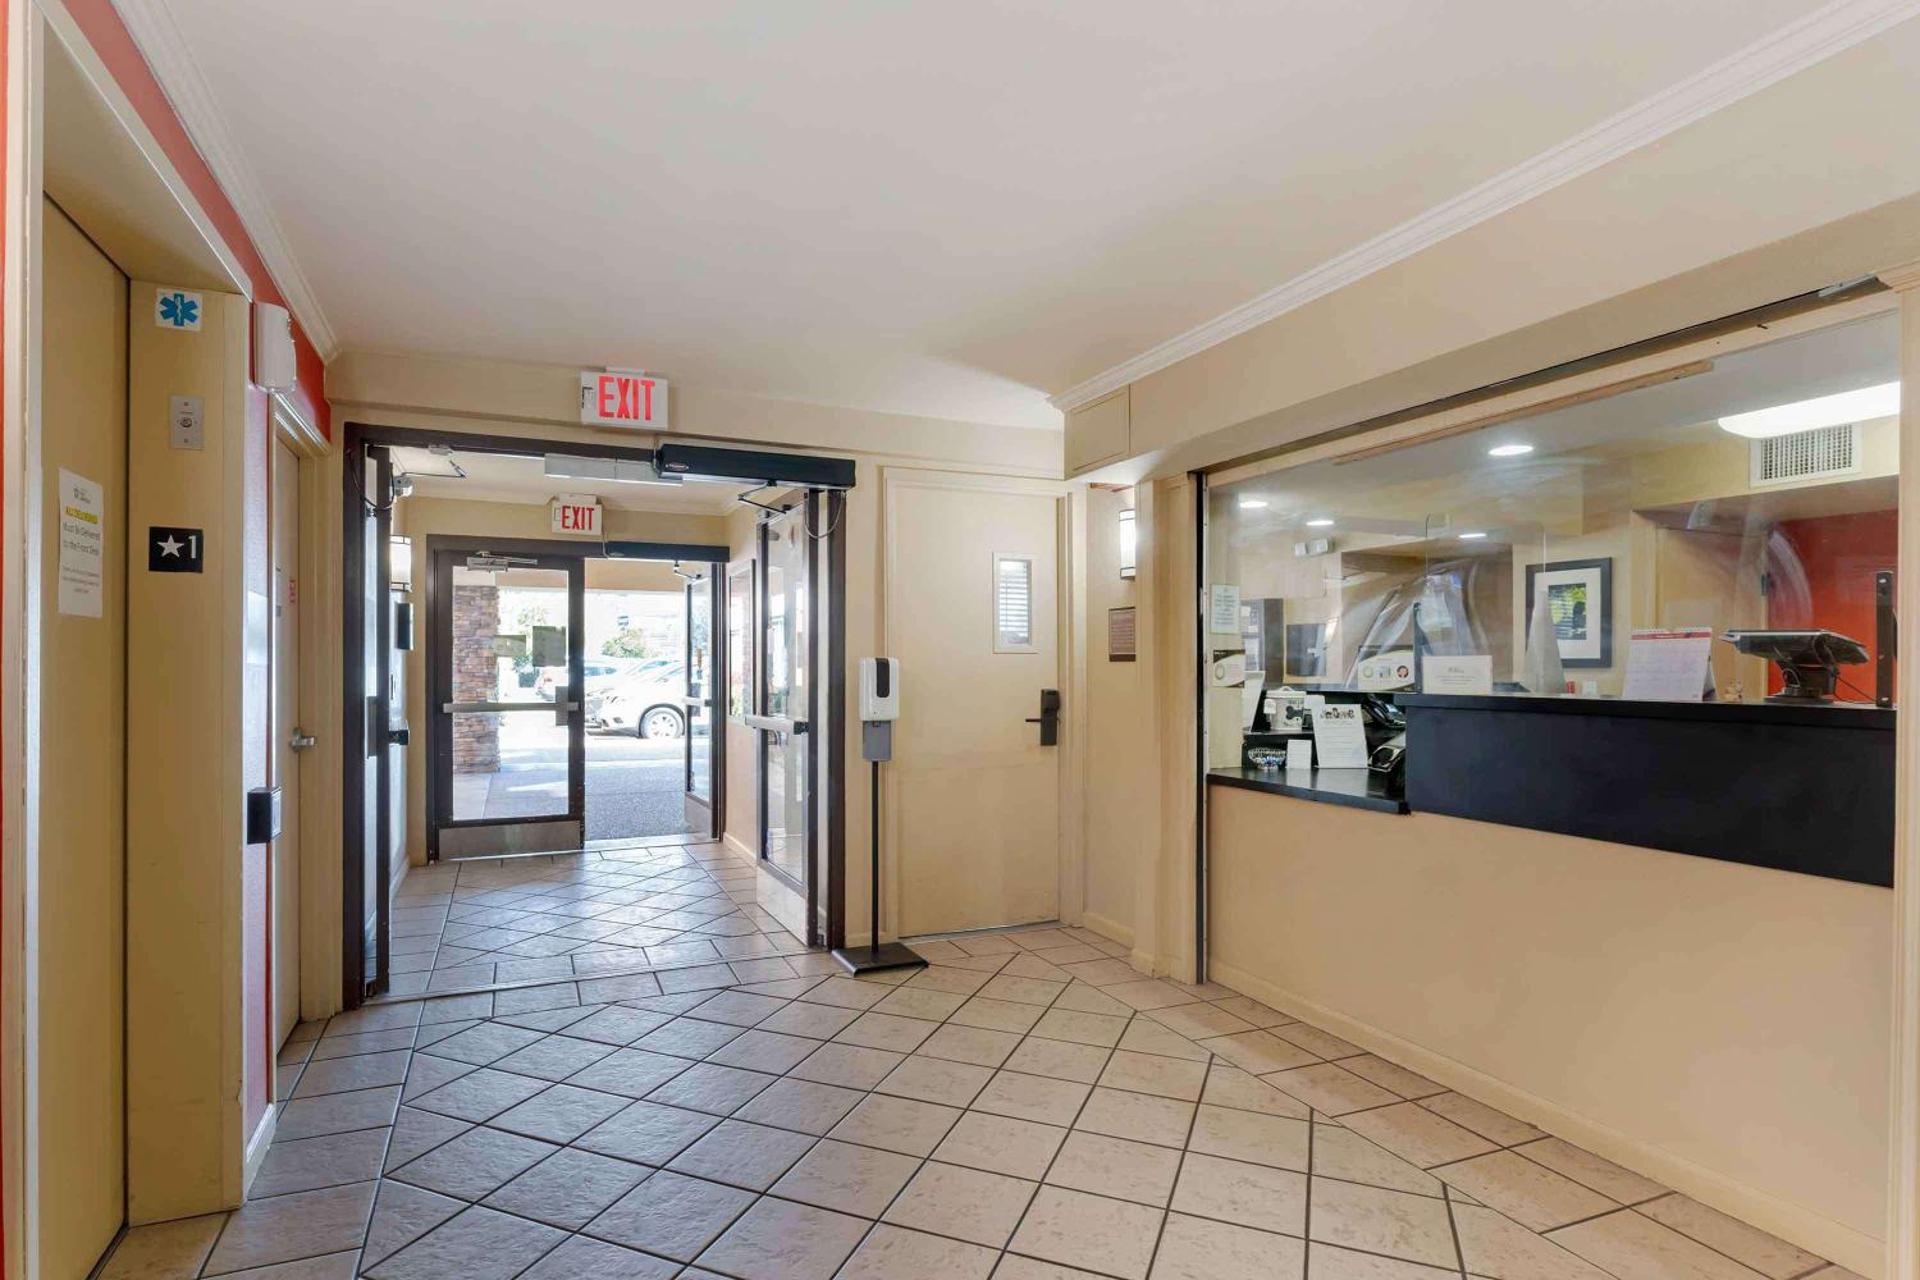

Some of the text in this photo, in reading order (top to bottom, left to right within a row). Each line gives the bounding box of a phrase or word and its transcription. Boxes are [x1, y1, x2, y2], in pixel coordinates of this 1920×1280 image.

[599, 376, 655, 420] EXIT
[562, 505, 594, 530] EXIT
[188, 535, 197, 559] 1
